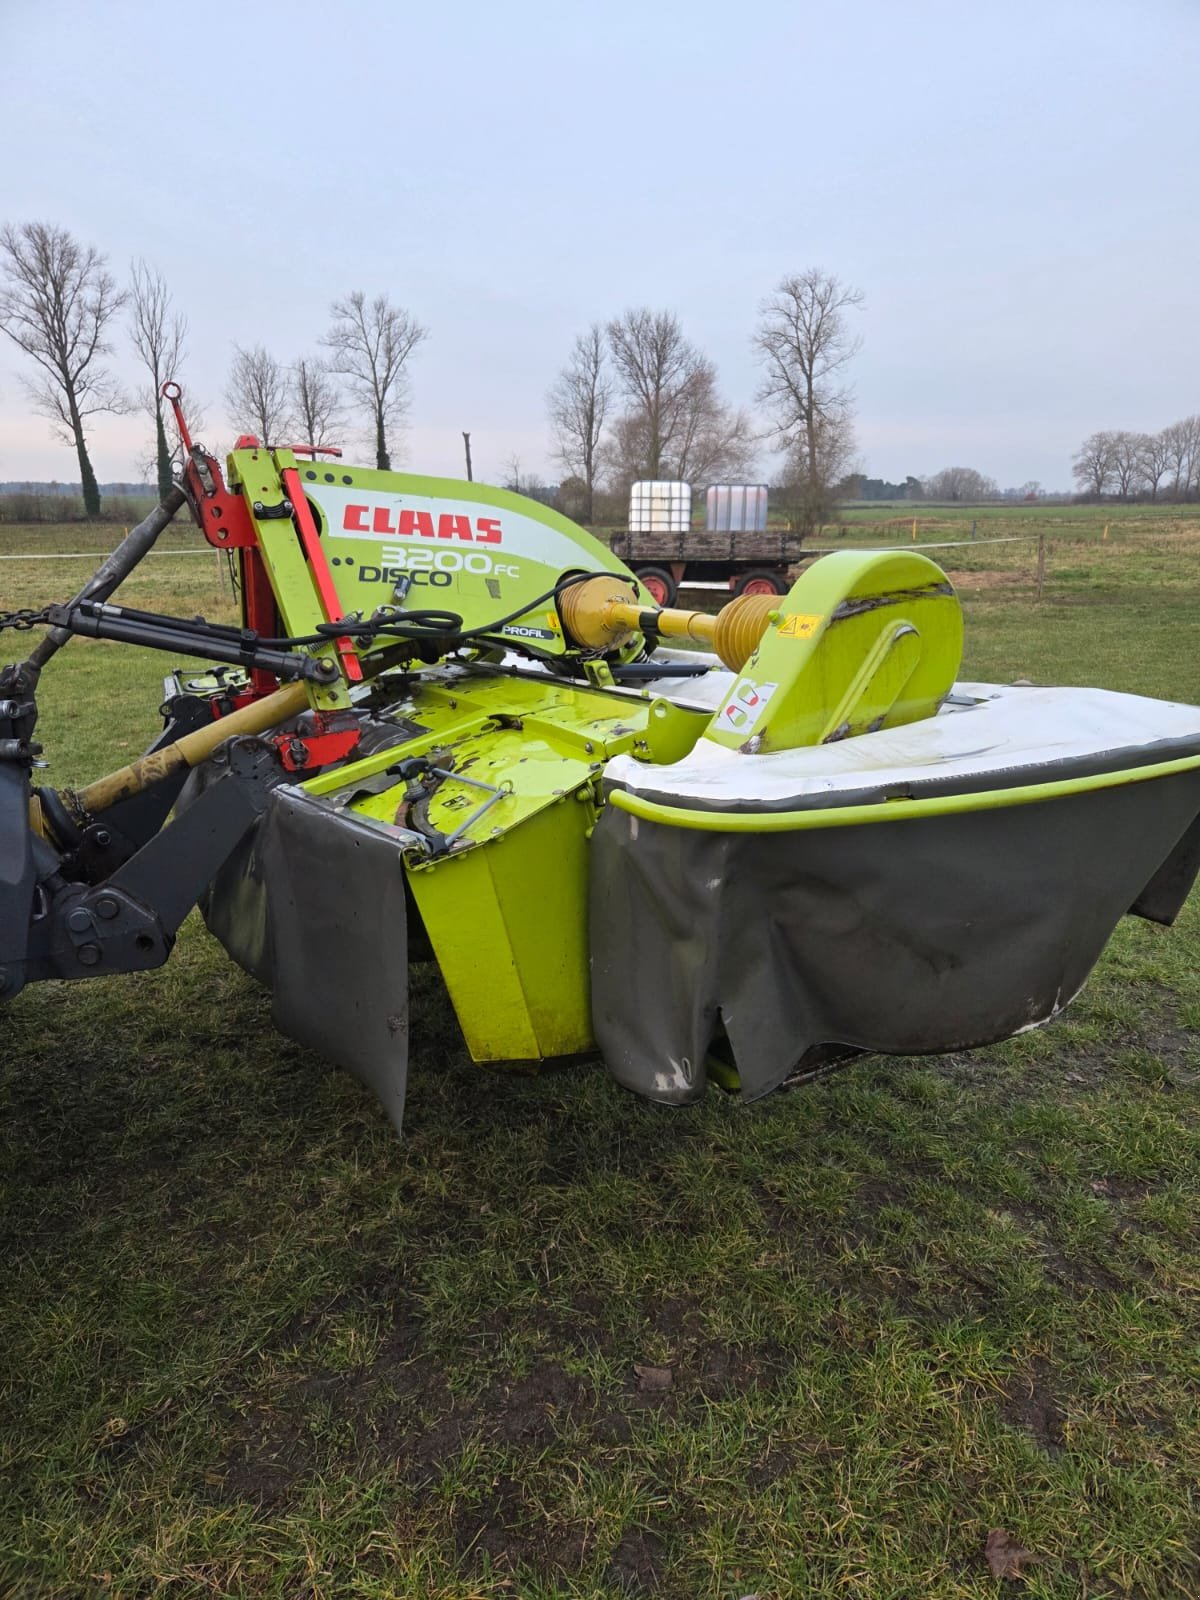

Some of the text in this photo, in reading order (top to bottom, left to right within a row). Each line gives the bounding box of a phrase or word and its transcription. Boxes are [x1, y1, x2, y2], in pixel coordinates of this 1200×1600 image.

[343, 504, 502, 544] CLAAS
[358, 566, 452, 587] DISCO
[503, 626, 545, 638] PROFIL
